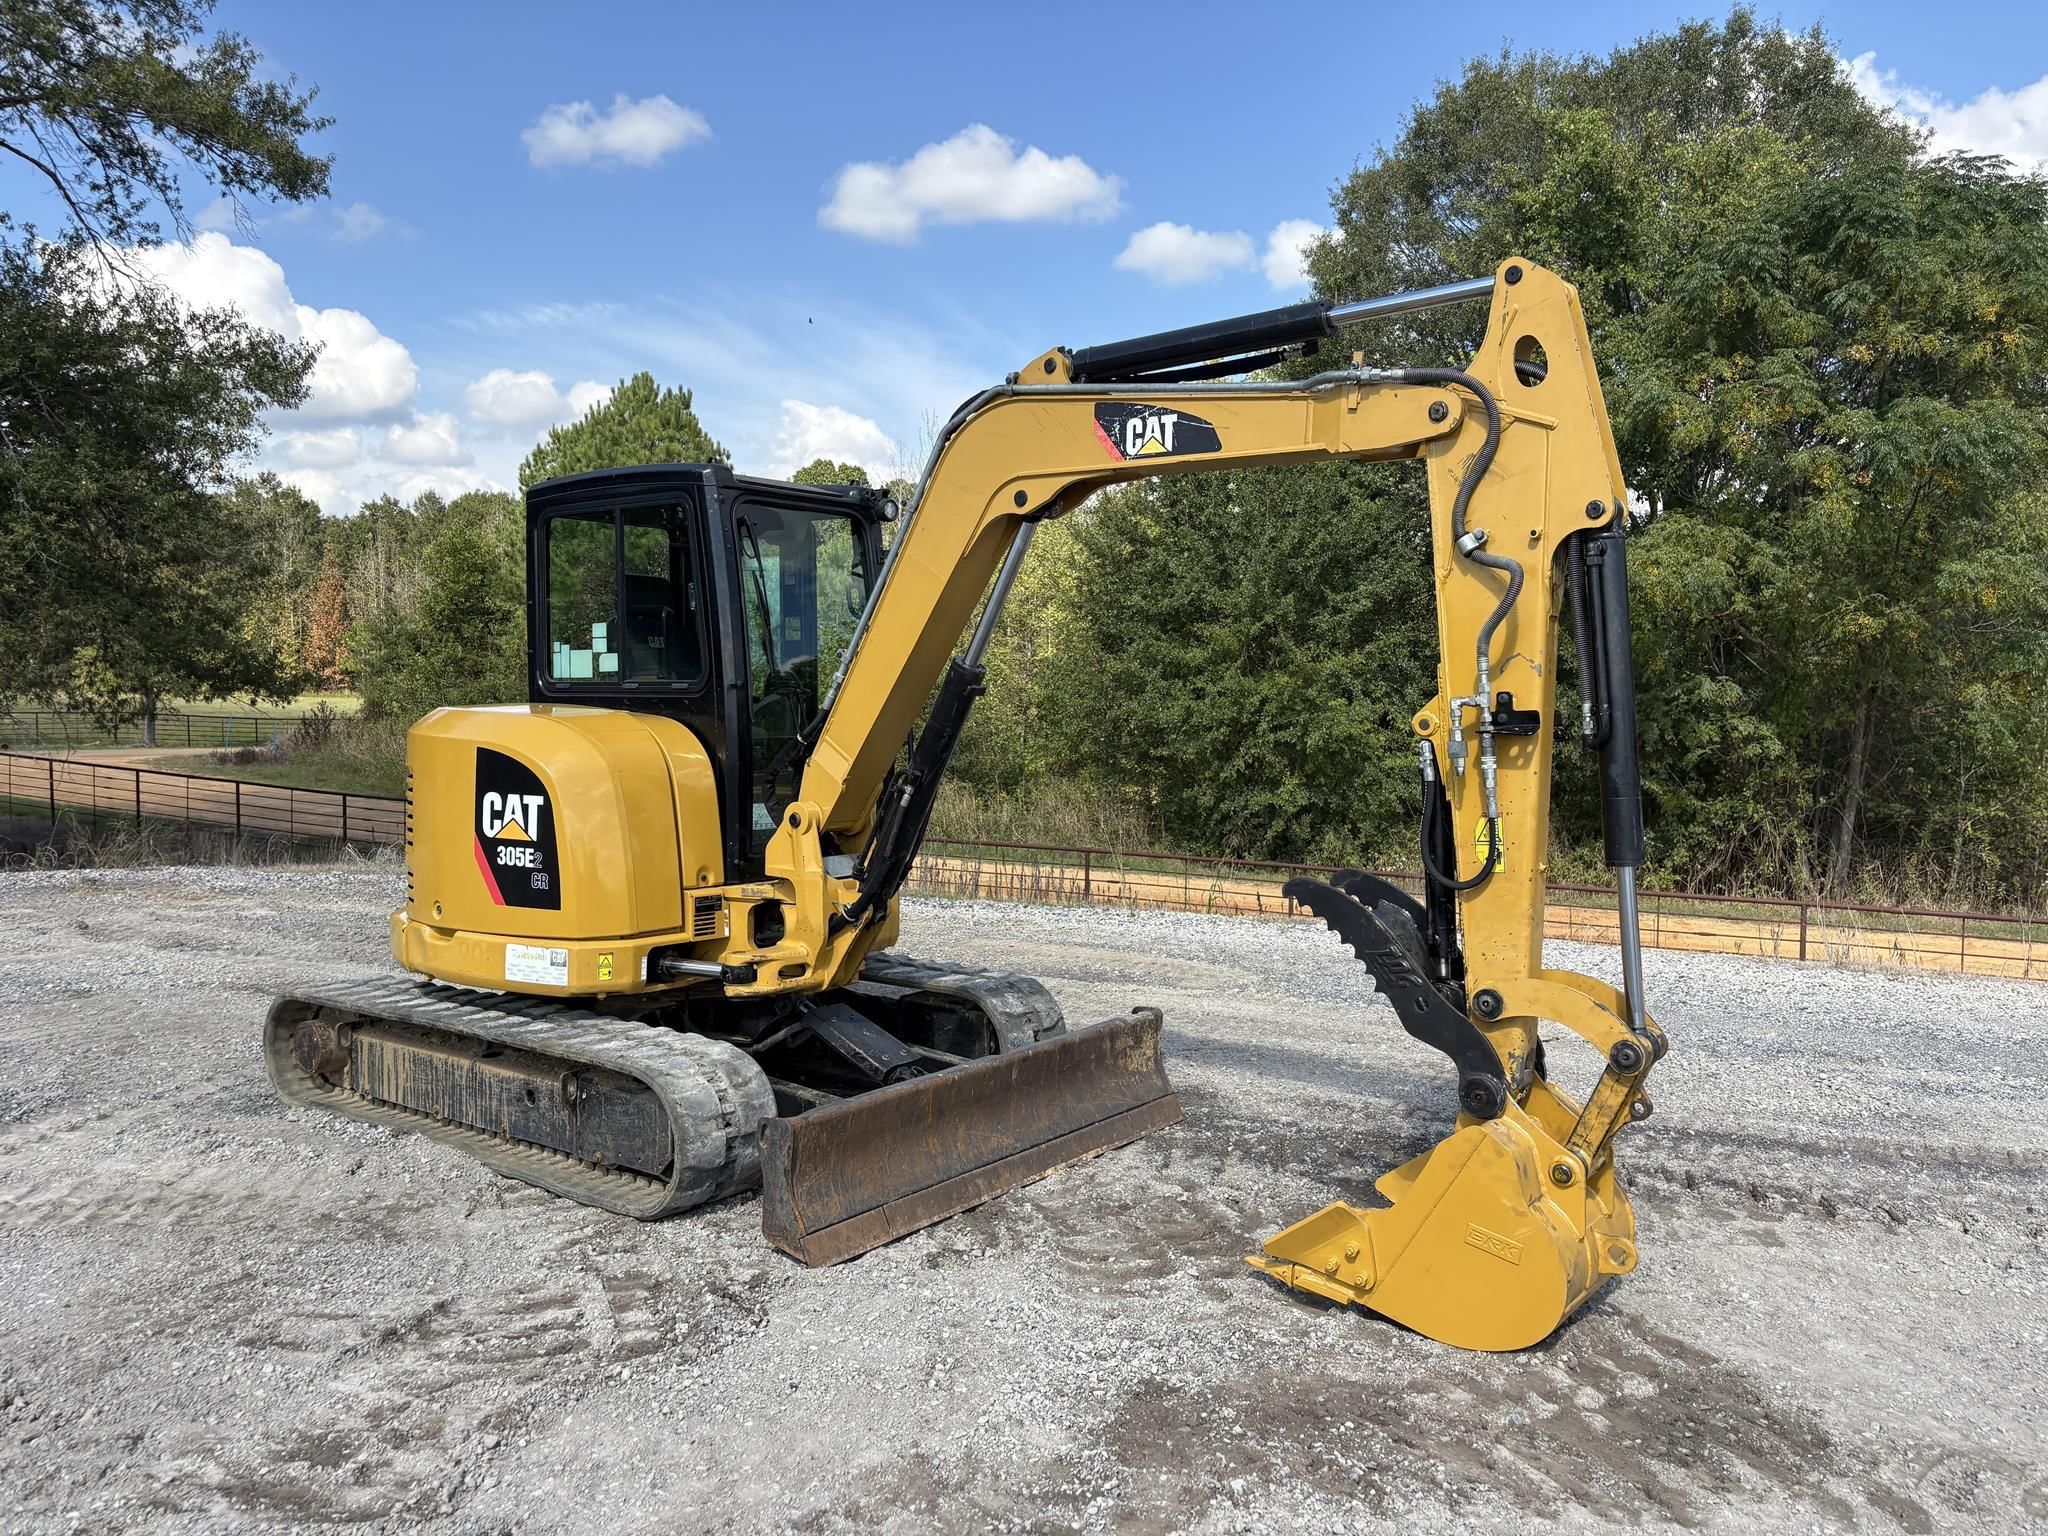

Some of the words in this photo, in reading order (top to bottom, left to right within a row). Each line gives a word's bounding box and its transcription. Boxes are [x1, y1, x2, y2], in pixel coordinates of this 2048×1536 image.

[1125, 413, 1178, 456] CAT
[482, 791, 544, 842] CAT
[496, 845, 543, 868] 305E2
[531, 872, 549, 890] CR
